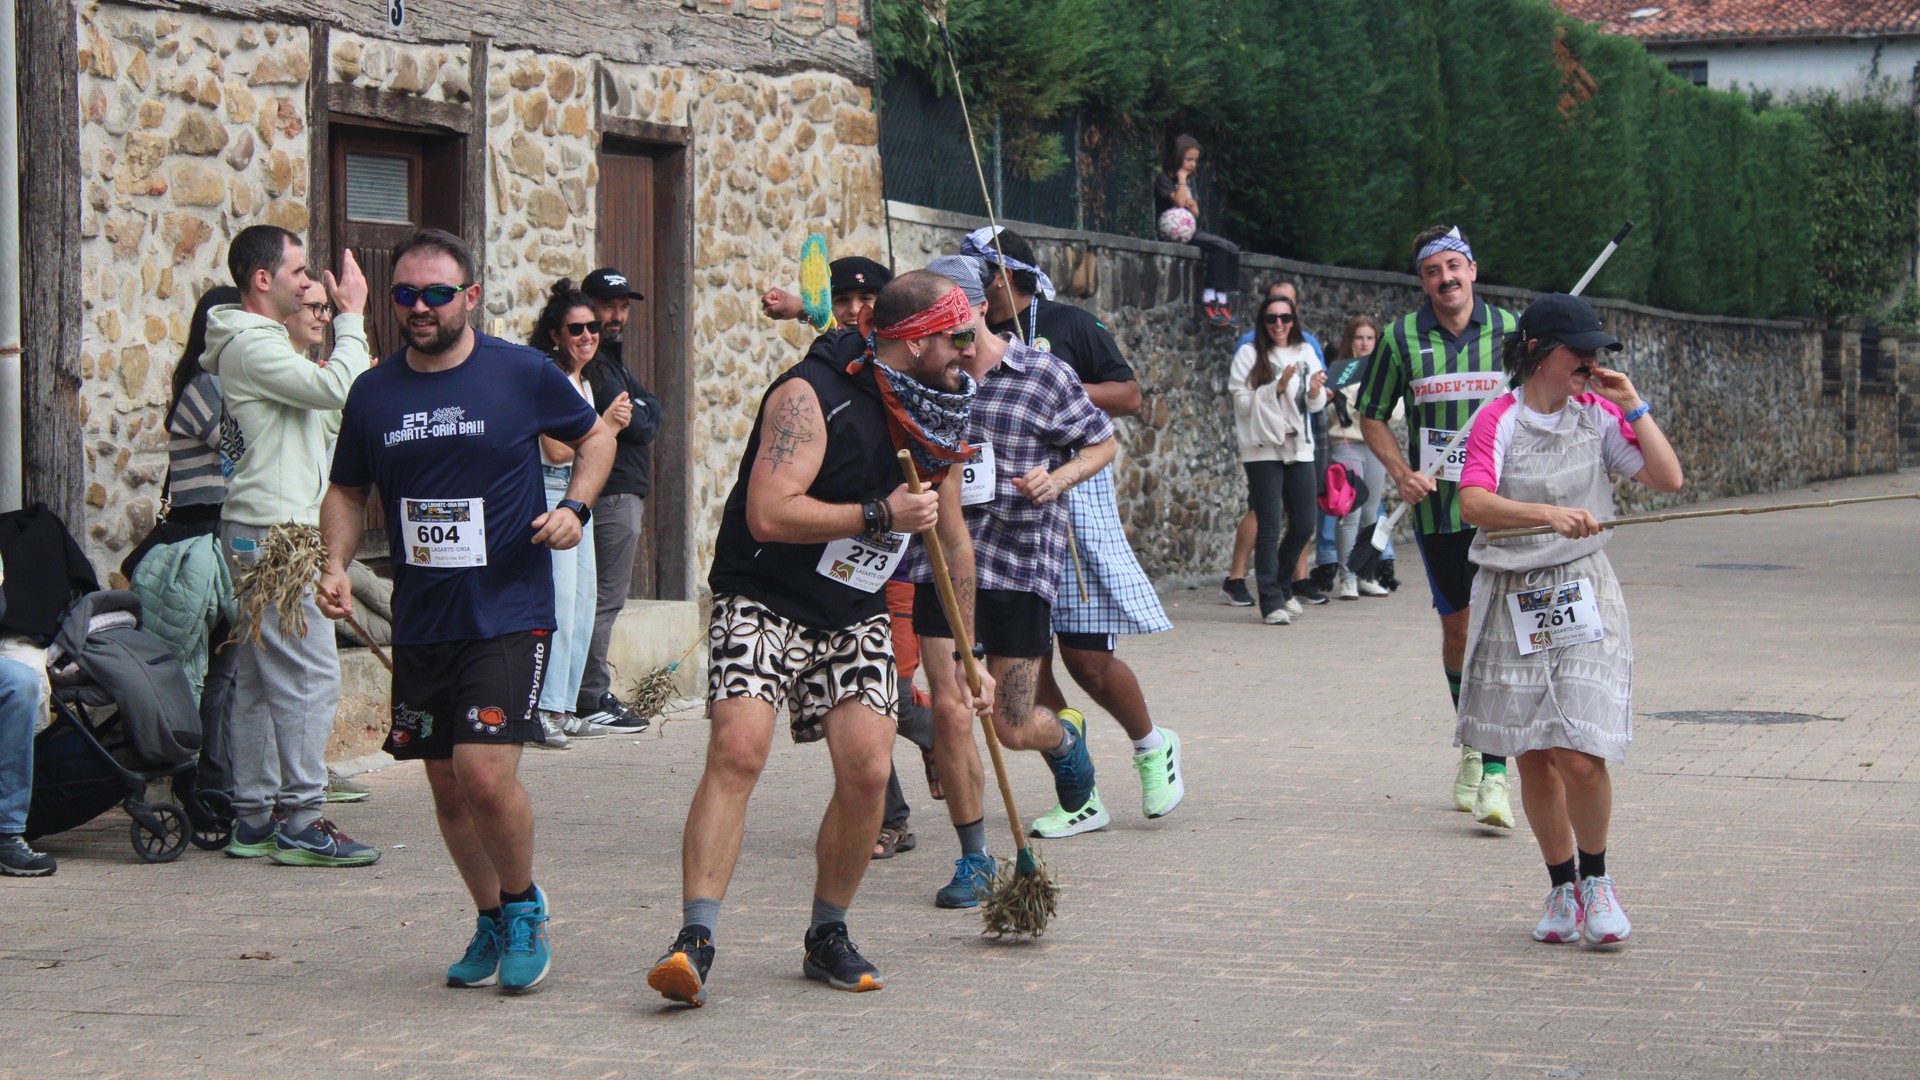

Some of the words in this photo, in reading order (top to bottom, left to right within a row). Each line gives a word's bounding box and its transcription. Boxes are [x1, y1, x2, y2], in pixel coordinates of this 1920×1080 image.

[403, 411, 428, 429] 29
[417, 525, 460, 544] 604
[846, 544, 888, 571] 273
[1535, 606, 1576, 629] 261
[524, 642, 545, 720] babyauto
